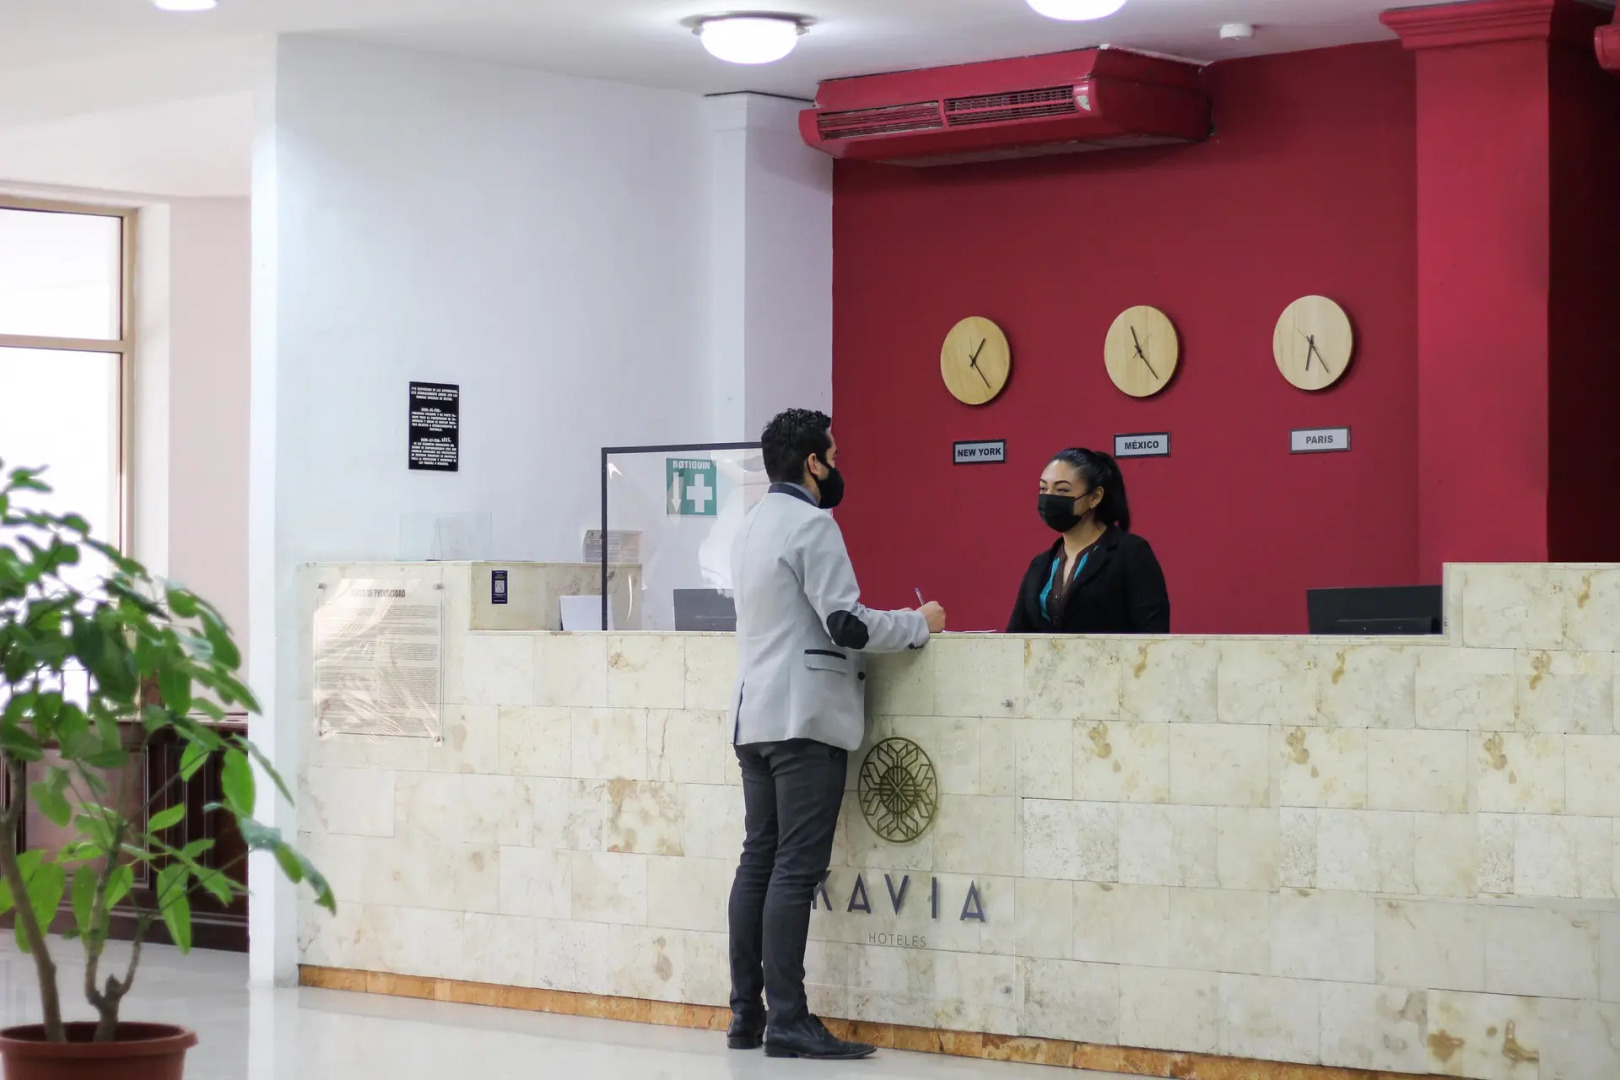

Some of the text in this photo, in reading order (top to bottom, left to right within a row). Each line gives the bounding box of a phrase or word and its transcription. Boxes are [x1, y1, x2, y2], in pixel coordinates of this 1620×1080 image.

[1124, 440, 1159, 450] MÉXICO
[1305, 435, 1334, 445] PARIS
[957, 447, 1001, 457] NEW YORK
[812, 869, 986, 923] KAVIA
[868, 933, 927, 948] HOTELES
